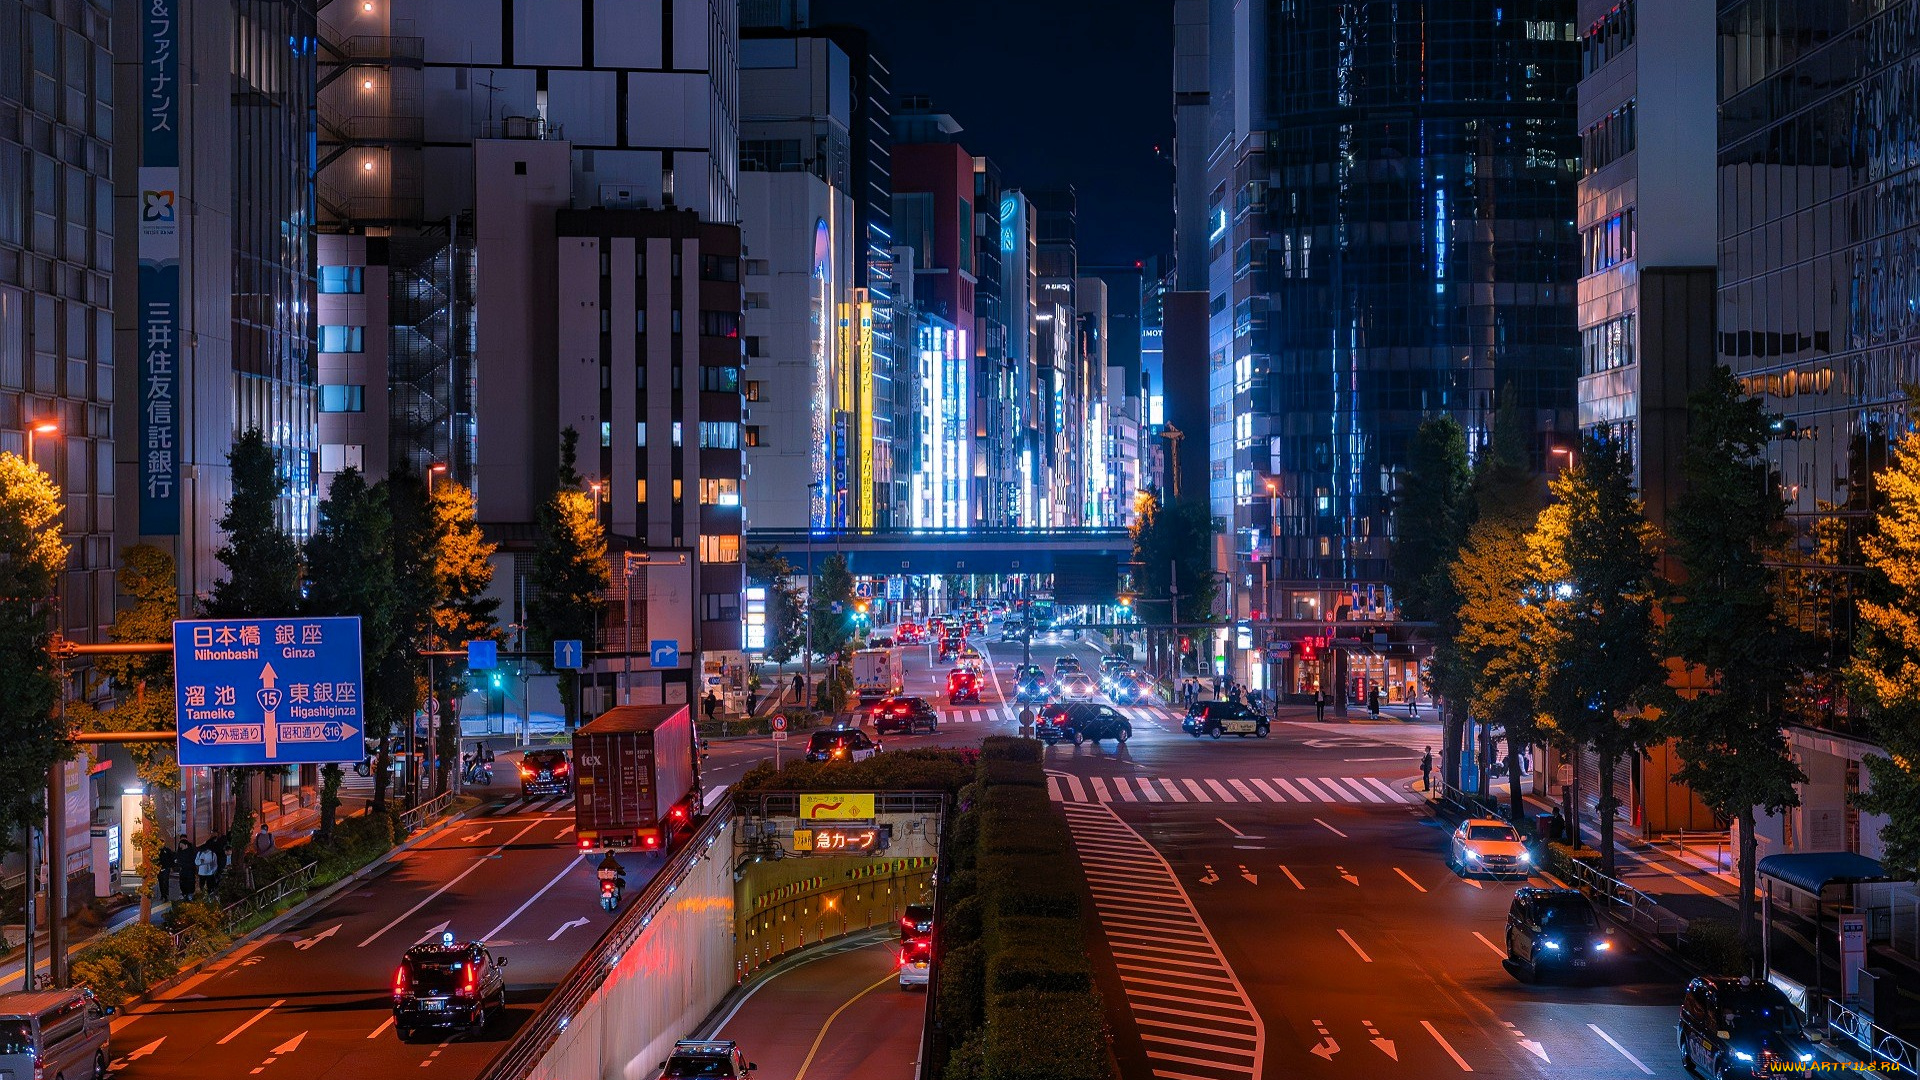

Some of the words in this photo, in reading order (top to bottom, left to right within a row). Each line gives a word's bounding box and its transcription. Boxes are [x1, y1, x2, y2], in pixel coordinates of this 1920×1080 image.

[147, 302, 172, 498] 三井住友信託銀行
[193, 625, 261, 647] 日本橋
[274, 624, 323, 645] 銀座
[194, 649, 259, 660] Nihonbashi
[282, 647, 316, 659] Ginza
[184, 685, 236, 706] 溜池
[262, 692, 277, 706] 15
[289, 682, 357, 704] 東銀座
[186, 708, 236, 720] Tameike
[290, 706, 356, 719] Higashiginza
[200, 730, 218, 740] 405
[219, 728, 260, 741] 外堀通り
[282, 727, 322, 739] 昭和通り
[324, 726, 340, 737] 316
[581, 753, 602, 767] tex
[816, 832, 875, 848] 急カーブ
